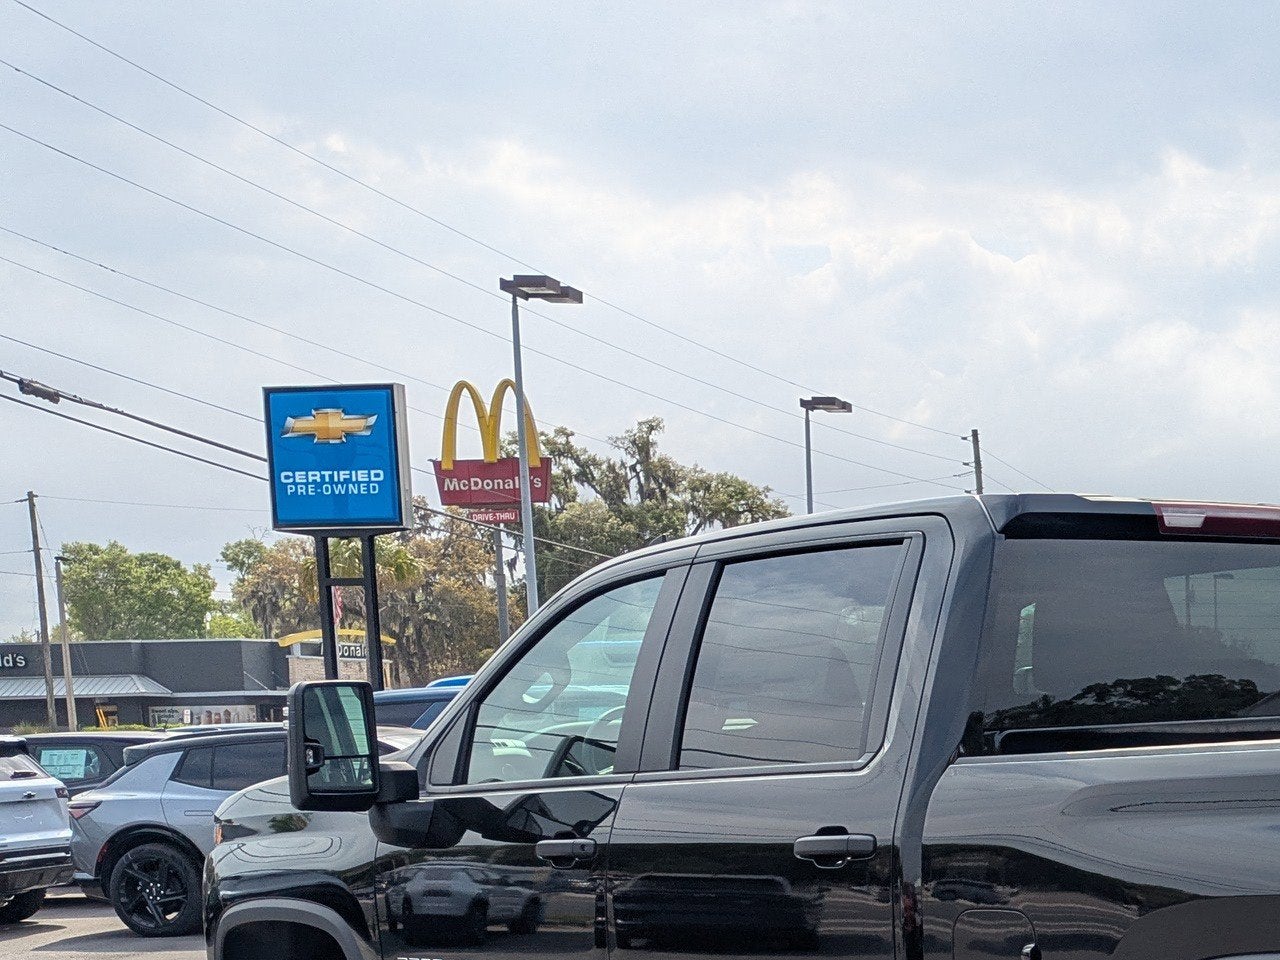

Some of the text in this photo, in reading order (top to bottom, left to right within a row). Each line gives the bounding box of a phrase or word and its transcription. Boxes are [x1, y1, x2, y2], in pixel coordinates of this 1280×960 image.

[280, 469, 385, 484] CERTIFIED
[287, 483, 379, 495] PRE-OWNED
[443, 476, 542, 491] McDonal's
[472, 512, 516, 522] DRIVE-THRU
